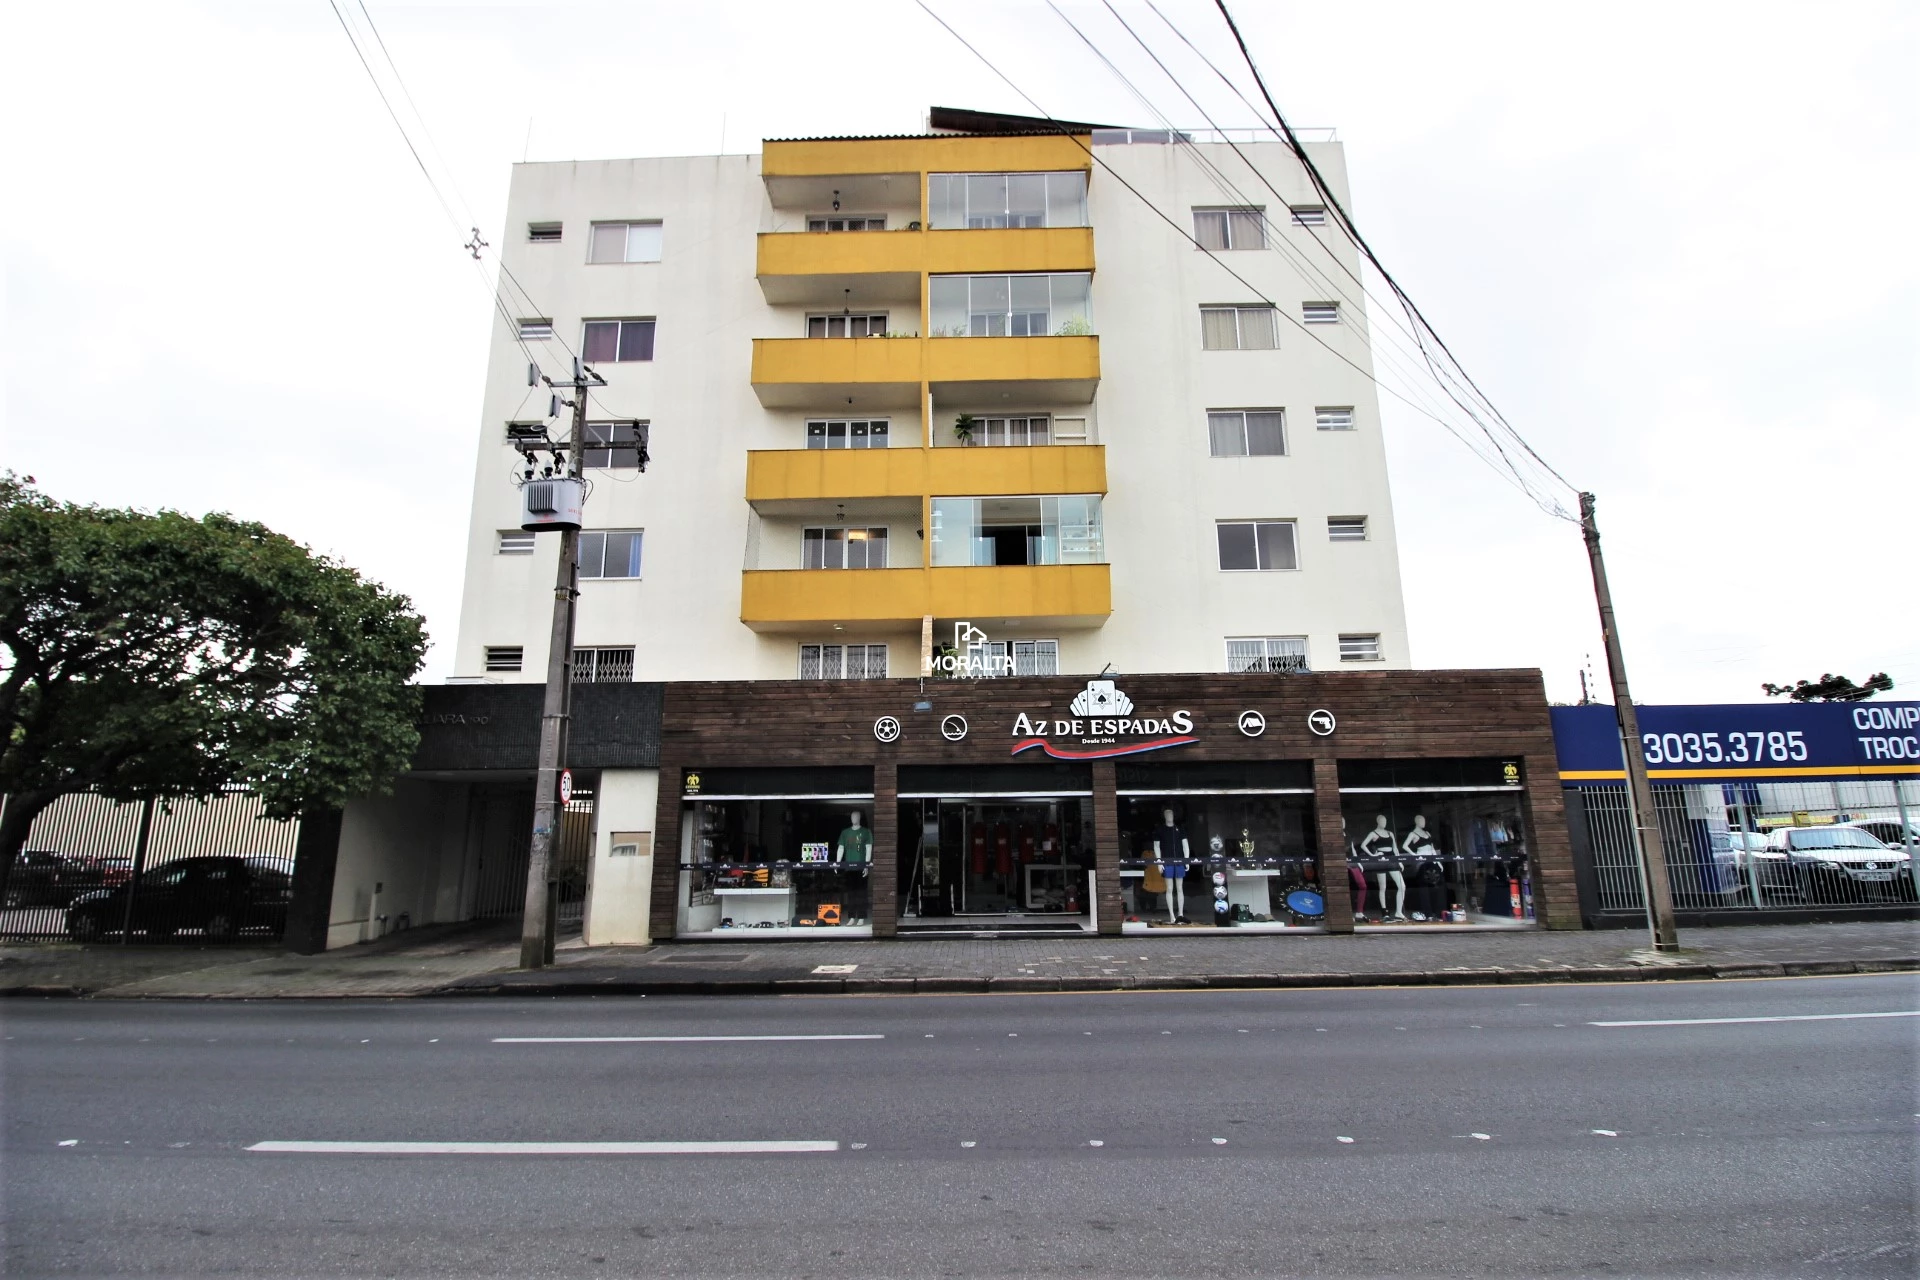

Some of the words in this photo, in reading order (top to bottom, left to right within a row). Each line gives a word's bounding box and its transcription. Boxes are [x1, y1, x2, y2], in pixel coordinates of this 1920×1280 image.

[1055, 721, 1084, 735] DE
[1091, 710, 1194, 735] ESPADAS
[1853, 708, 1920, 730] COMP
[1643, 732, 1807, 763] 3035.3785
[563, 777, 570, 791] 50
